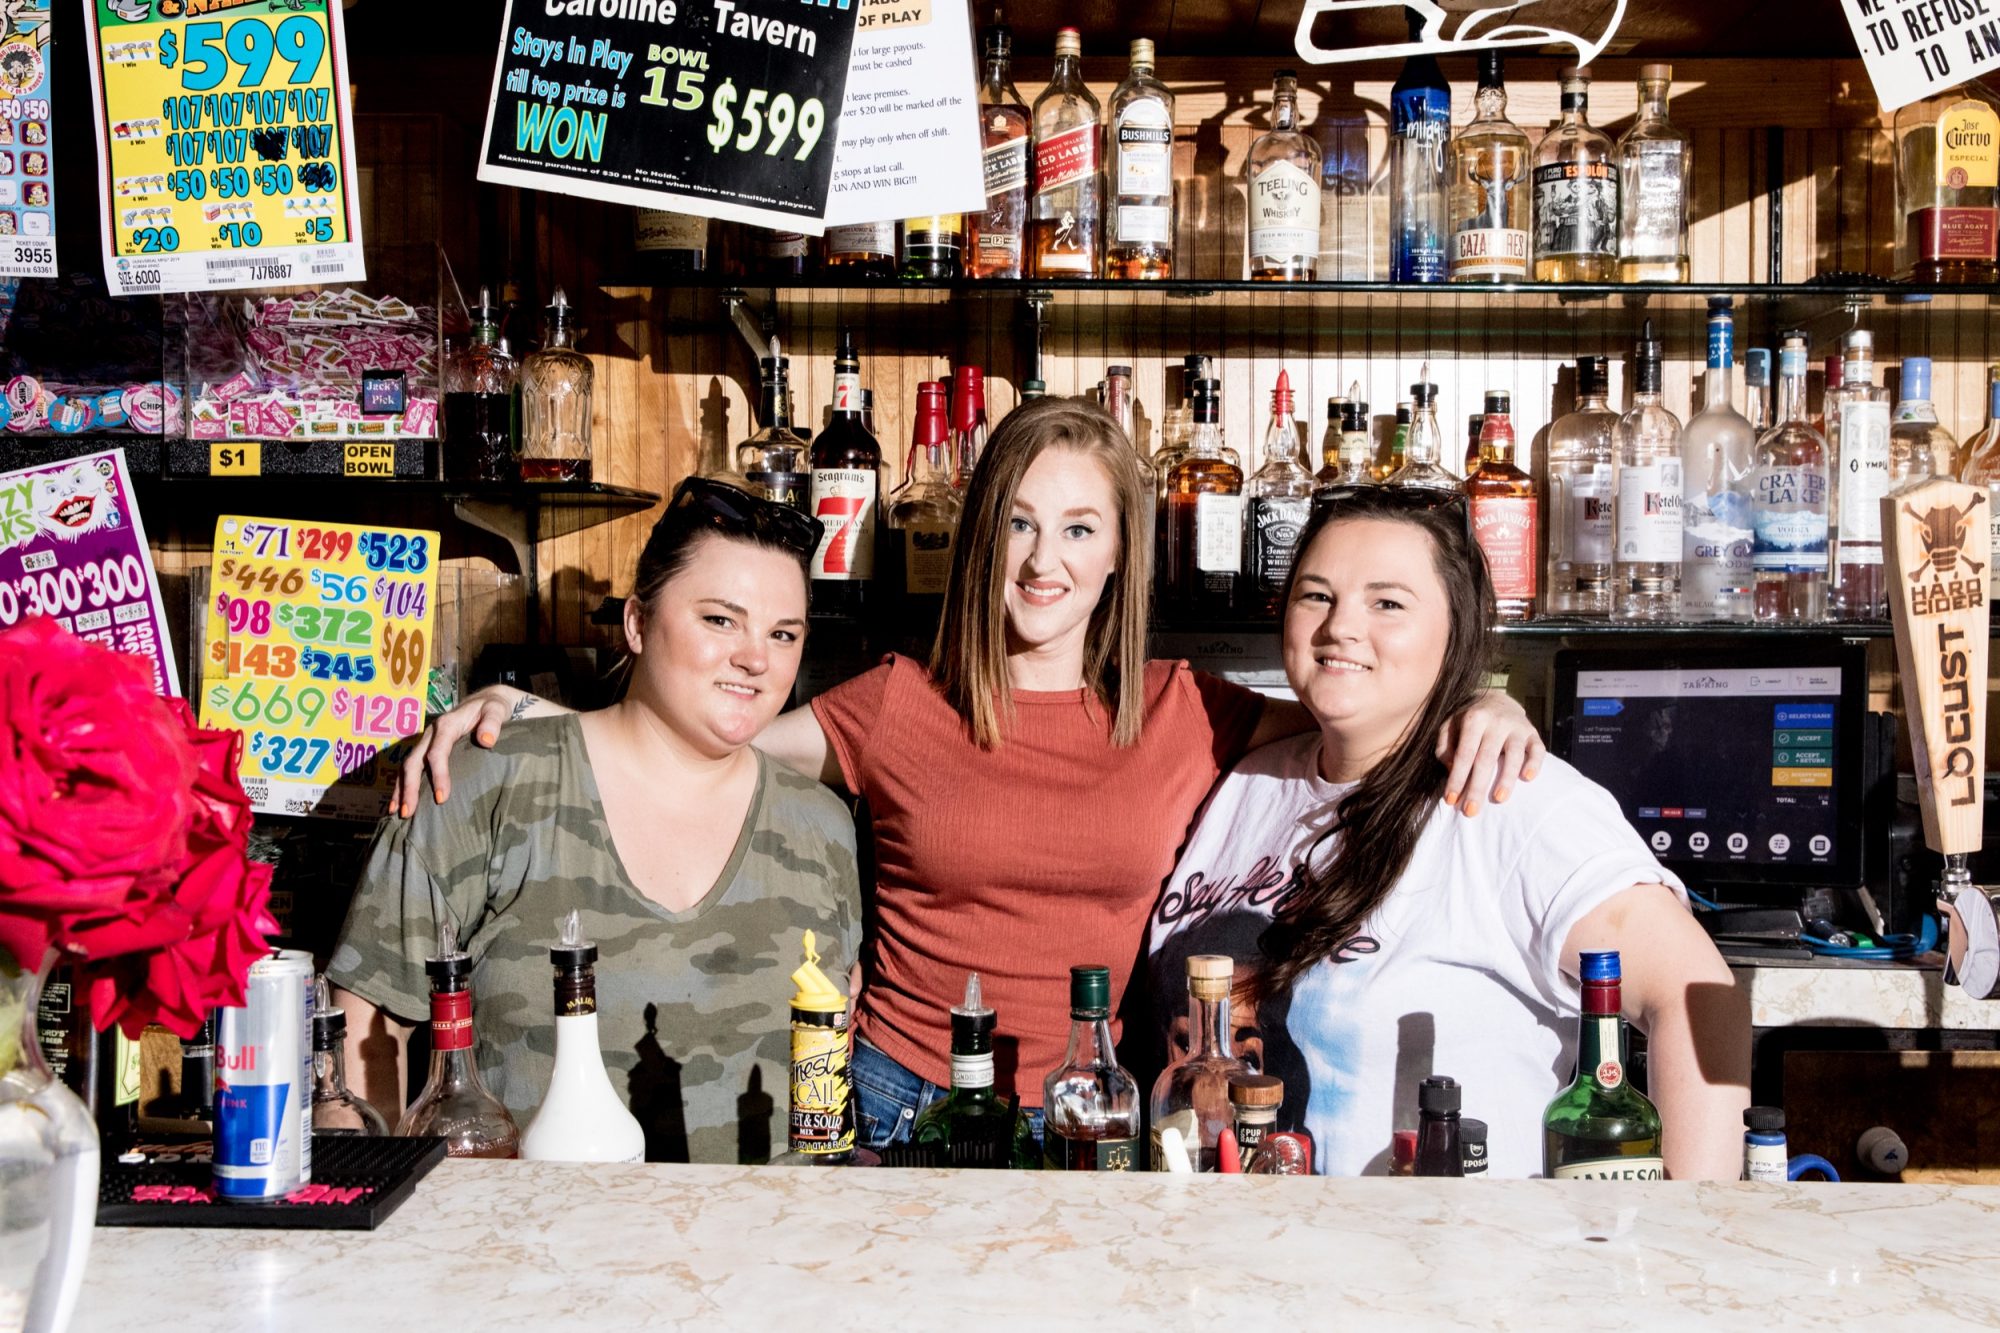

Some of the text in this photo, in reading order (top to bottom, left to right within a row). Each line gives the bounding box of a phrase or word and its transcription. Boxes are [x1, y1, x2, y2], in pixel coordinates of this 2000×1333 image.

[714, 0, 816, 57] Tavern
[882, 10, 922, 25] PLAY
[1866, 0, 1990, 56] TO REFUSE
[159, 15, 325, 91] $599
[512, 26, 634, 80] Stays In Play
[647, 44, 710, 70] BOWL
[858, 42, 926, 57] for large payouts.
[852, 56, 913, 72] must be cashed
[1915, 43, 1950, 82] TO
[506, 68, 626, 109] till top prize is
[640, 66, 705, 111] 15
[852, 88, 911, 103] leave premises.
[24, 99, 49, 121] $50
[163, 88, 330, 130] $107 $107 $107 $107
[860, 97, 962, 117] $20 will be marked off the
[707, 77, 825, 161] $599
[1962, 119, 1979, 131] Jose
[516, 100, 608, 163] WON
[842, 127, 951, 149] may play only when off shift.
[1121, 129, 1169, 141] BUSHMILLS
[1946, 127, 1991, 149] Cuervo
[166, 129, 248, 166] $107 $107
[650, 171, 680, 180] Holds.
[841, 168, 862, 180] stops
[874, 165, 887, 174] last
[889, 162, 905, 173] call.
[168, 165, 293, 202] $50 $50 $50
[498, 154, 543, 166] Maximum
[545, 161, 588, 173] purchase
[602, 170, 620, 178] $30
[642, 177, 663, 185] time
[665, 180, 691, 190] when
[692, 184, 719, 194] there
[738, 192, 777, 204] multiple
[778, 199, 816, 211] players.
[850, 176, 917, 191] AND WIN BIG!!!
[1258, 178, 1308, 196] TEELING
[133, 217, 334, 253] $20 $10 $5
[14, 247, 52, 263] 3955
[33, 265, 52, 273] 63361
[118, 269, 161, 285] SIZE: 6000
[250, 264, 292, 281] 7J76887
[366, 381, 399, 391] Jack's
[837, 385, 852, 408] 7
[371, 394, 395, 405] Pick
[219, 446, 392, 468] $1 OPEN
[346, 462, 393, 474] BOWL
[818, 472, 865, 483] Seagram's
[1257, 511, 1279, 528] JACK
[1475, 508, 1532, 530] JACK DANIEL'S
[226, 540, 235, 550] $1
[816, 496, 866, 574] 7
[243, 523, 429, 574] $71 $299 $523
[1695, 545, 1728, 558] GREY
[1491, 557, 1516, 565] FIRE
[78, 554, 146, 607] $300
[220, 559, 369, 604] $446 $56
[1911, 577, 1981, 600] HARD
[374, 576, 427, 619] $104
[1912, 592, 1984, 616] CIDER
[116, 621, 154, 643] $25
[217, 592, 426, 687] $98 $372 $69
[210, 640, 299, 681] $143
[301, 647, 377, 684] $245
[209, 681, 422, 738] $669 $126
[1937, 623, 1977, 808] LOCUST
[250, 732, 332, 777] $327
[335, 737, 379, 788] $203
[804, 1113, 843, 1130] & SOUR
